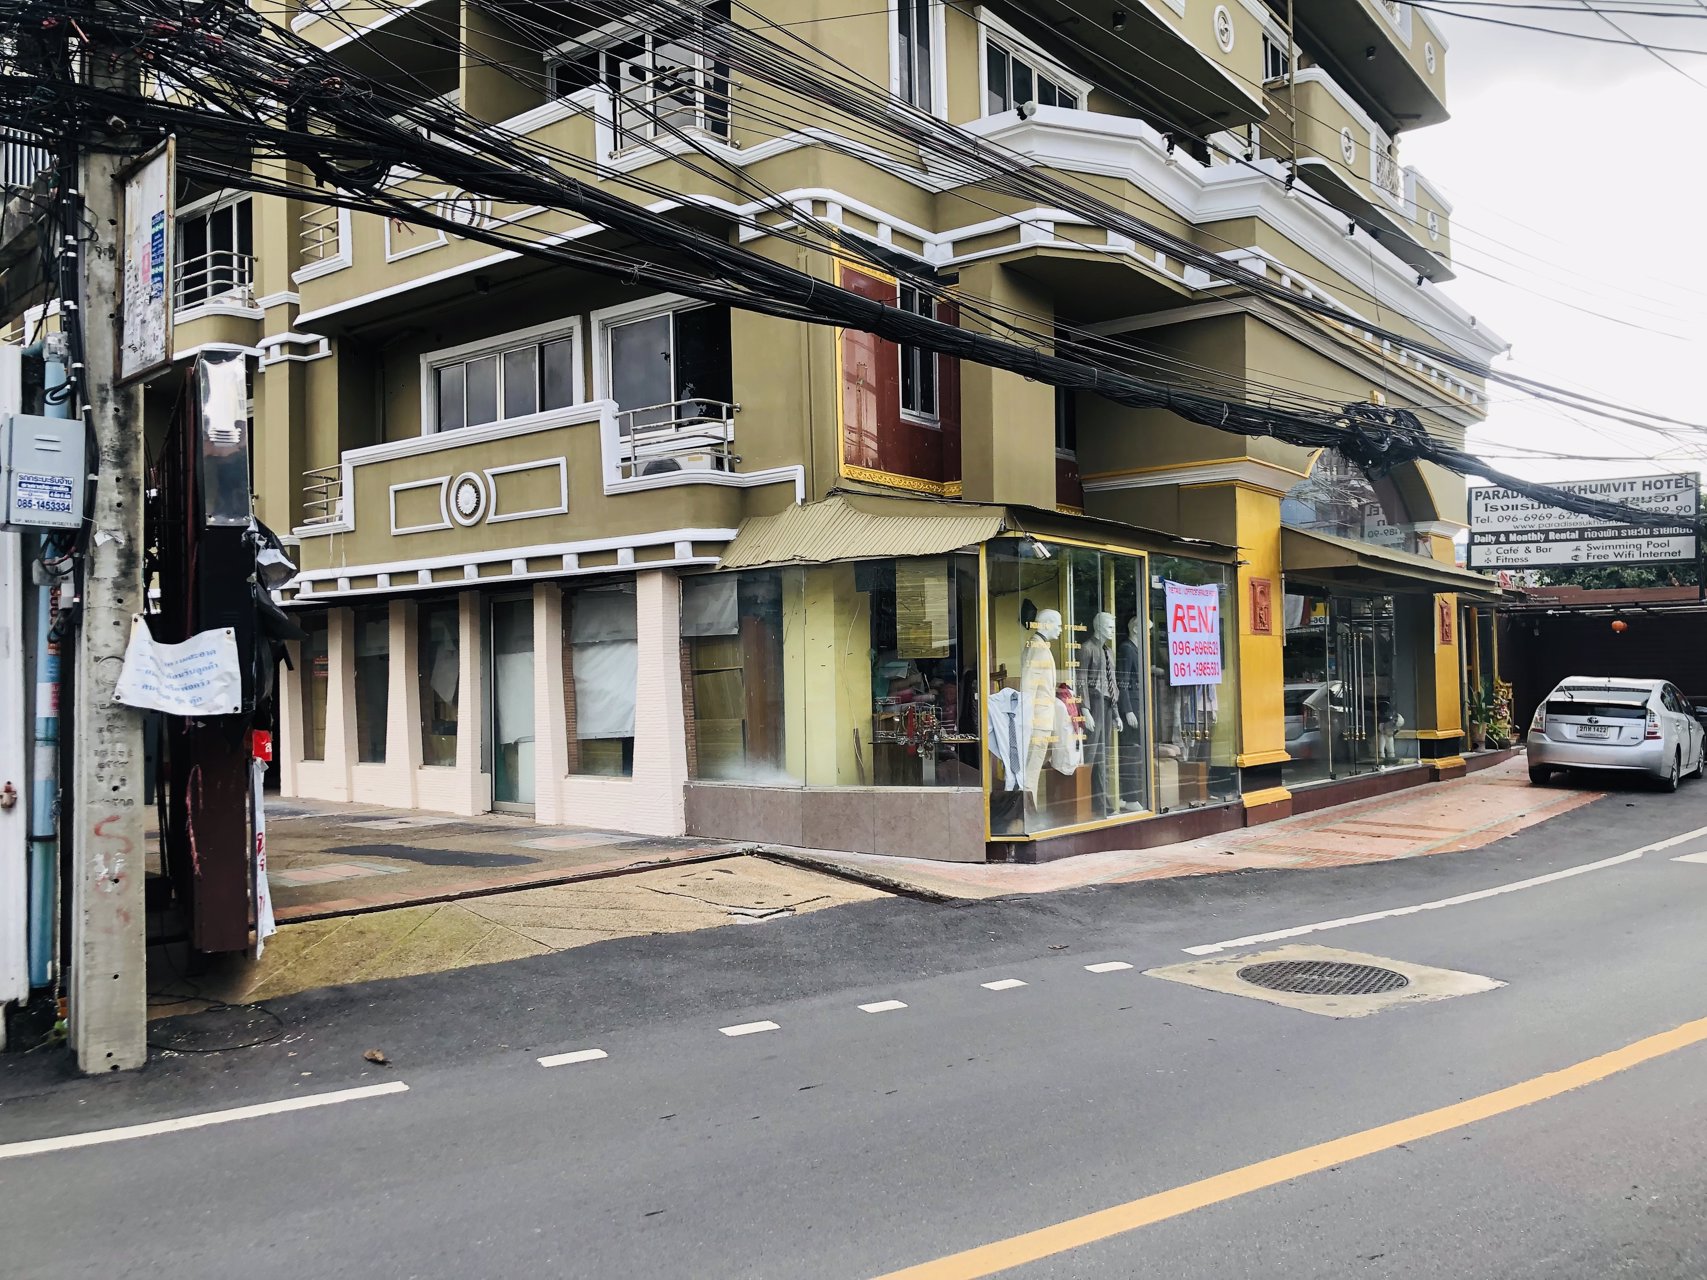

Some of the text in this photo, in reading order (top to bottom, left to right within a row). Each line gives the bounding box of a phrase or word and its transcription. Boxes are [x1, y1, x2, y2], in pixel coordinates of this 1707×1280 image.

[1642, 477, 1693, 491] HOTEL
[1474, 534, 1497, 544] Daily
[1499, 533, 1506, 542] &
[1509, 532, 1546, 542] Monthly
[1549, 530, 1579, 540] Rental
[1524, 546, 1532, 554] &
[1536, 545, 1552, 553] Bar
[1586, 539, 1670, 551] Swimming Pool
[1496, 555, 1529, 563] Fitness
[1586, 549, 1682, 560] Free Wifi Internet
[1172, 603, 1216, 633] RENT
